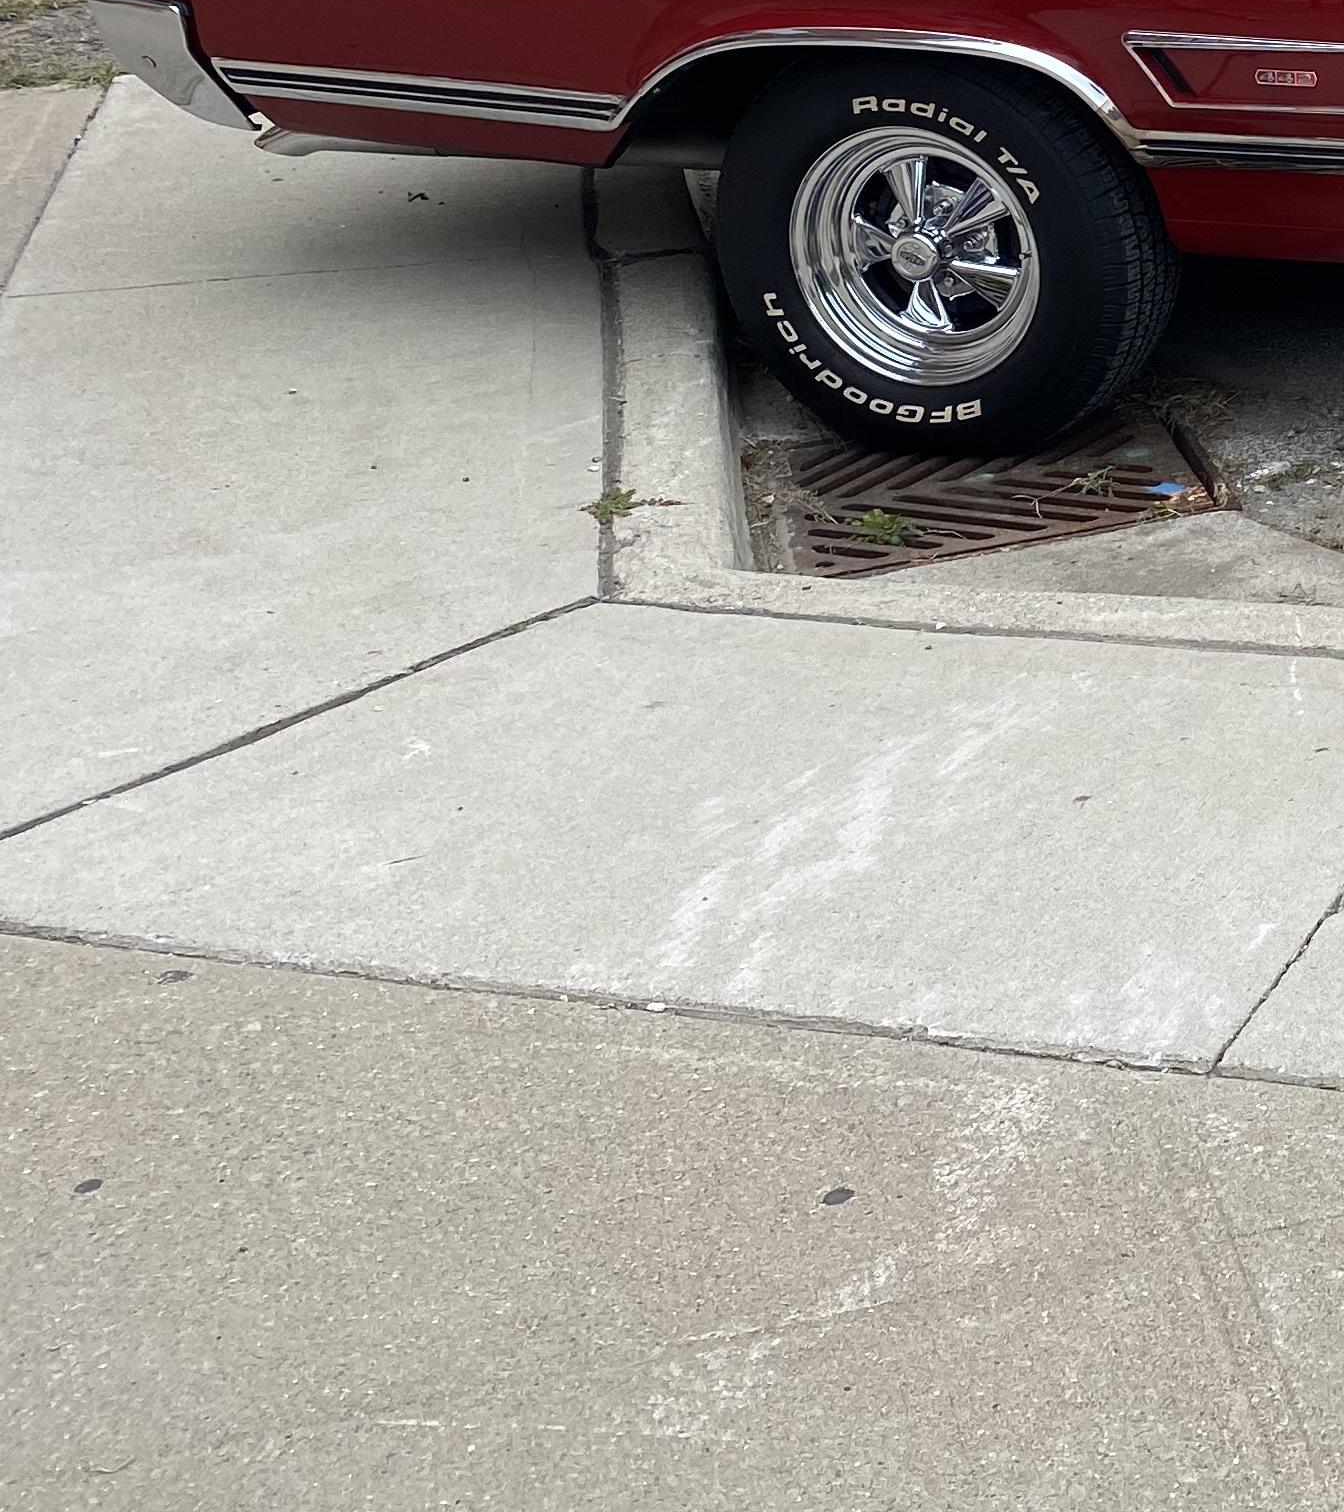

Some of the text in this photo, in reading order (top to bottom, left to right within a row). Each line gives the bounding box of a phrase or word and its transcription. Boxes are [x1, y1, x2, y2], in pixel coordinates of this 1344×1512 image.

[852, 96, 1041, 205] Radial T/A
[762, 292, 983, 424] BFGoodrich
